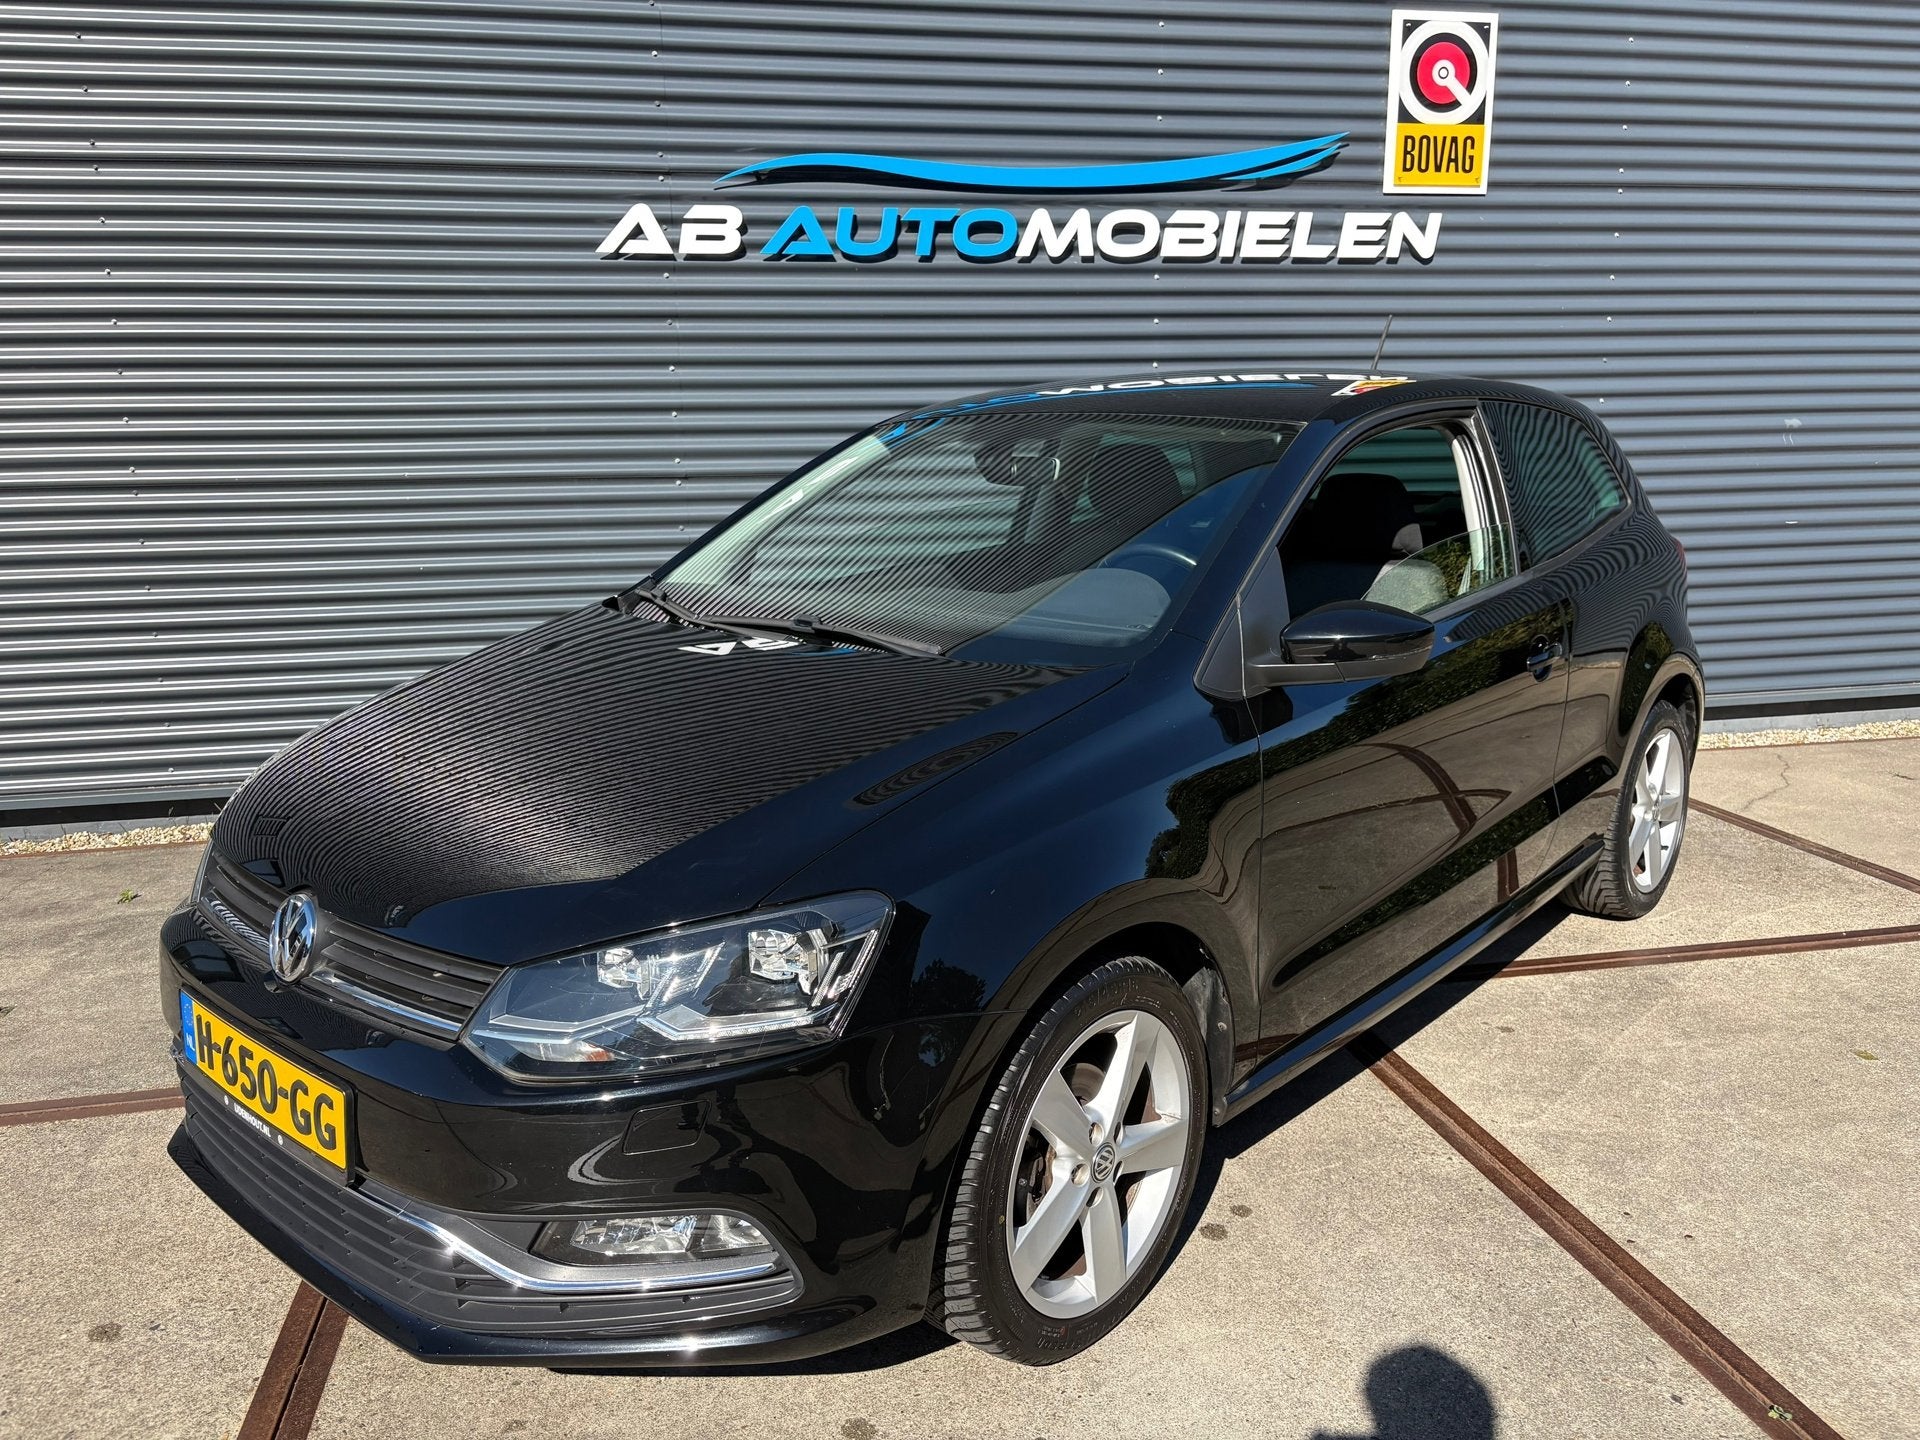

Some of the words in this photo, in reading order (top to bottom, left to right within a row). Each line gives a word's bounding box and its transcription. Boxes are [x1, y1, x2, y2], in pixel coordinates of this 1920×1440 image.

[1402, 134, 1476, 174] BOVAG
[595, 203, 744, 256] AB
[760, 205, 1443, 260] AUTOMOBIELEN
[185, 1032, 196, 1052] NL
[196, 1013, 337, 1150] H-650-GG
